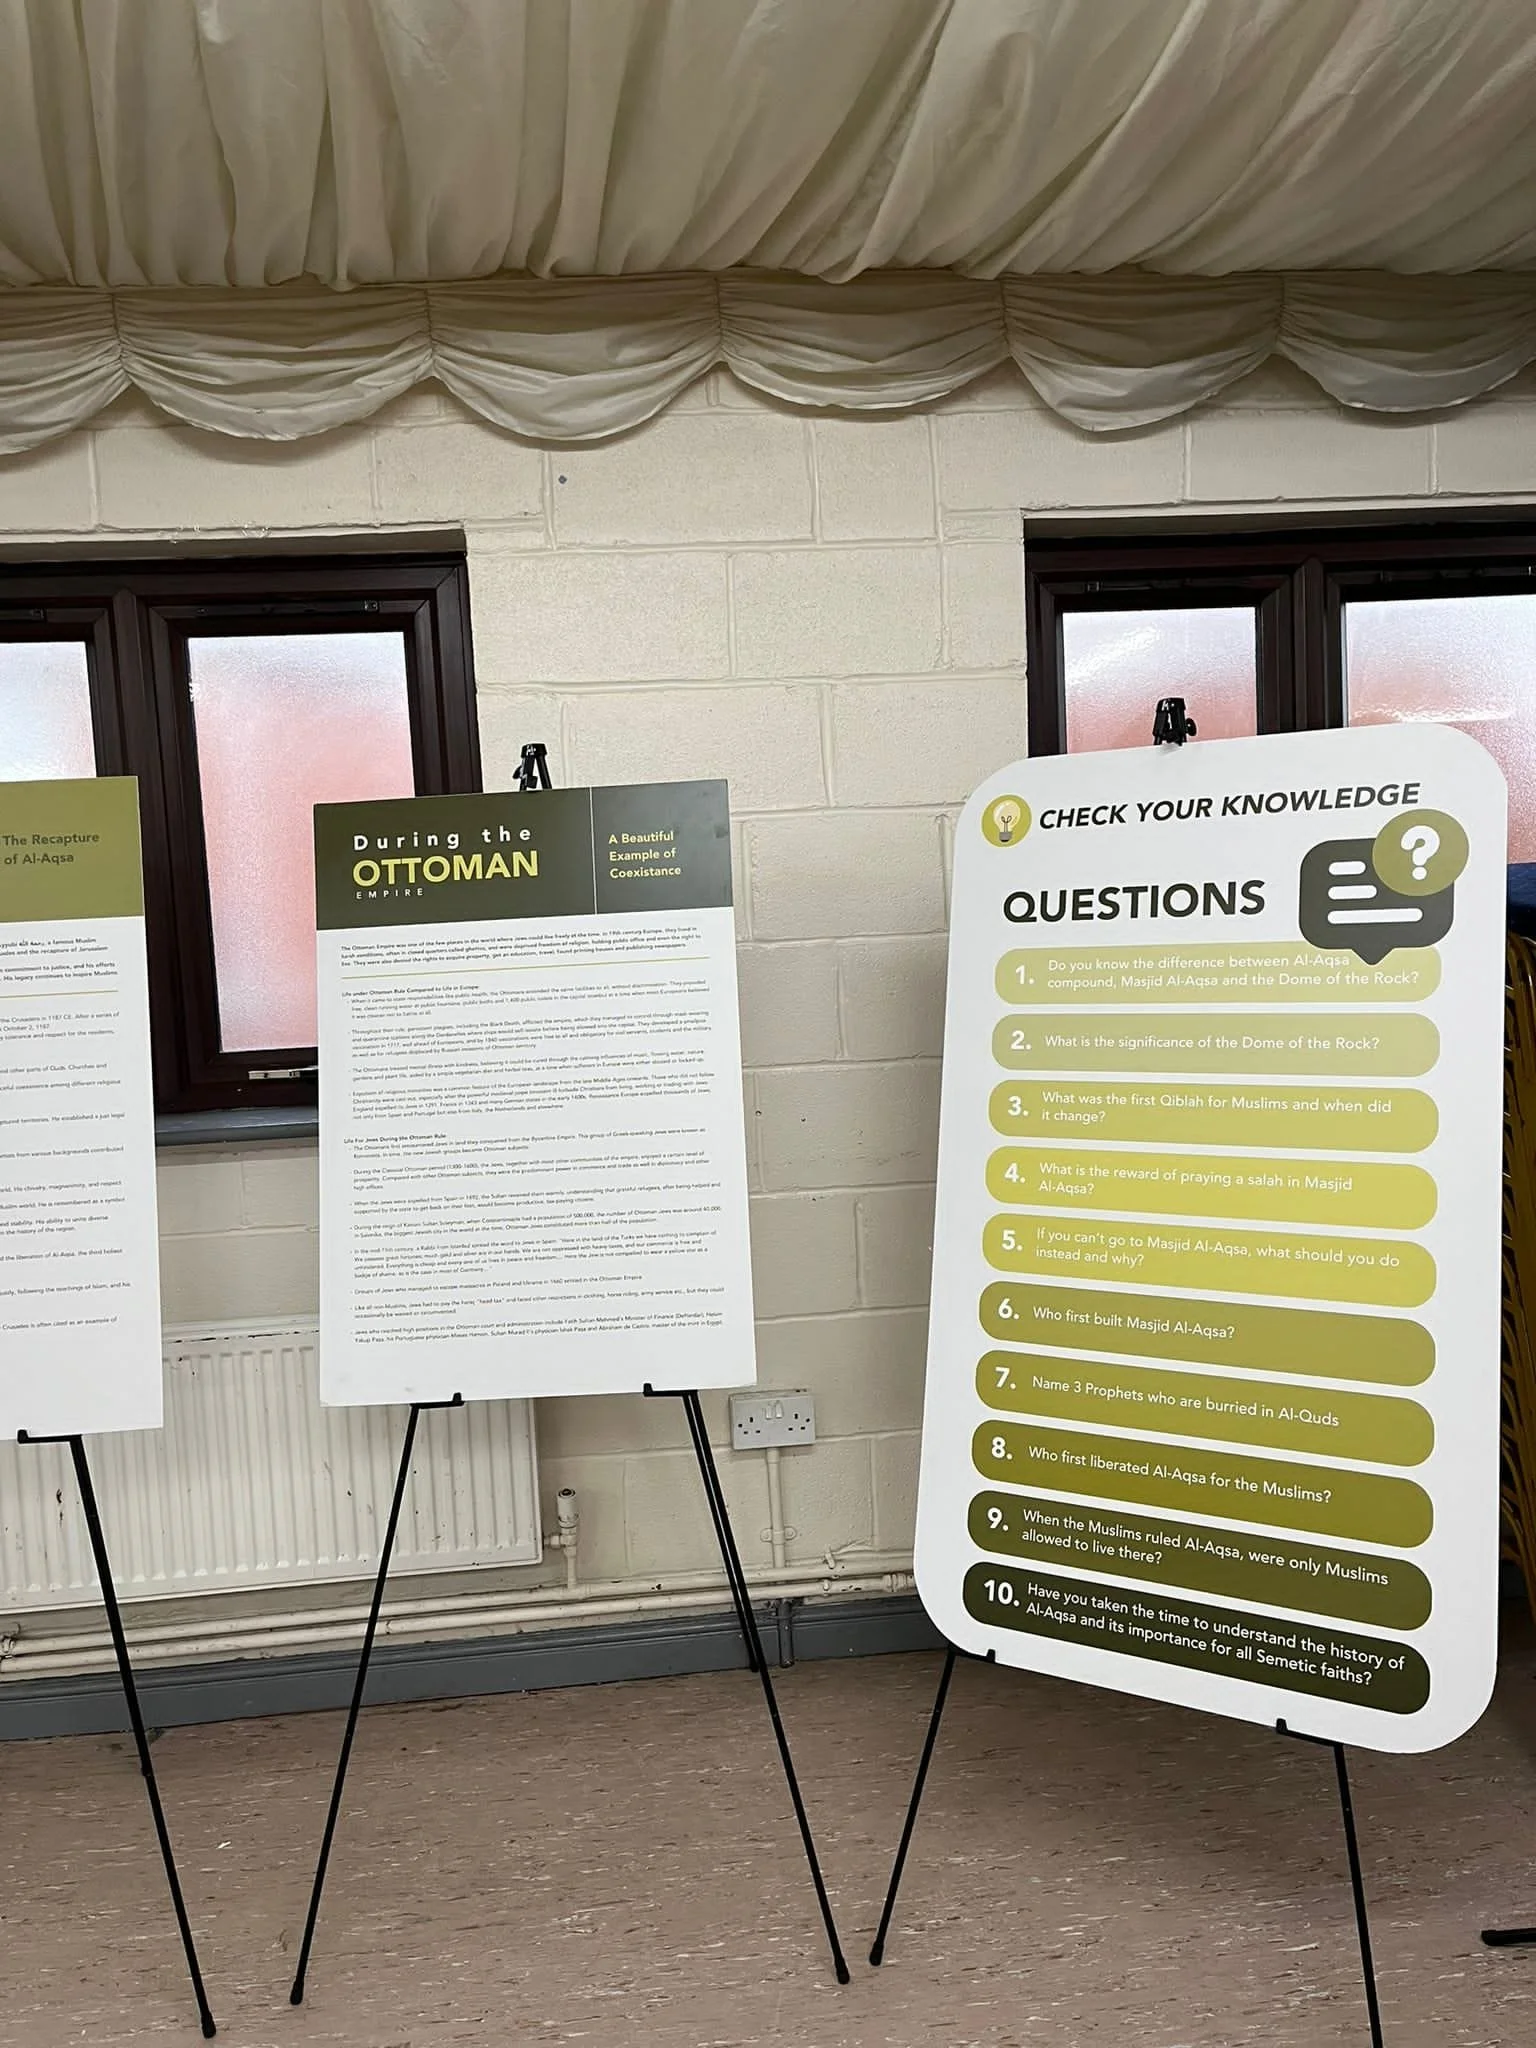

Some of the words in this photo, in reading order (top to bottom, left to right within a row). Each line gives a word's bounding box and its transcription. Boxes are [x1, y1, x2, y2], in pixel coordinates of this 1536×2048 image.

[1040, 804, 1127, 828] CHECK
[1137, 798, 1212, 821] YOUR
[1221, 783, 1419, 816] KNOWLEDGE
[4, 834, 26, 845] The
[32, 834, 99, 846] Recapture
[354, 832, 458, 850] During
[482, 825, 530, 842] the
[609, 834, 617, 843] A
[622, 830, 673, 843] Beautiful
[4, 853, 17, 864] of
[22, 853, 73, 865] Al-Aqsa
[609, 849, 659, 861] Example
[664, 847, 675, 857] of
[353, 850, 537, 886] OTTOMAN
[610, 867, 680, 878] Coexistance
[356, 888, 423, 899] EMPIRE
[1003, 880, 1264, 922] QUESTIONS
[1048, 959, 1065, 970] Do
[1070, 962, 1092, 973] you
[1096, 959, 1129, 969] know
[1133, 958, 1153, 968] the
[1158, 956, 1224, 968] difference
[1229, 956, 1288, 967] between
[1293, 954, 1349, 968] Al-Aqsa
[1016, 965, 1034, 984] 1.
[1048, 976, 1116, 991] compound,
[1121, 975, 1162, 989] Masjid
[1166, 975, 1217, 988] Al-Aqsa
[1222, 974, 1247, 985] and
[1252, 973, 1274, 985] the
[1279, 973, 1321, 984] Dome
[1326, 971, 1340, 984] of
[1345, 972, 1368, 984] the
[1374, 971, 1418, 983] Rock?
[1011, 1030, 1031, 1049] 2.
[1045, 1035, 1078, 1046] What
[1081, 1036, 1090, 1046] is
[1094, 1035, 1114, 1046] the
[1119, 1035, 1193, 1049] significance
[1198, 1036, 1211, 1047] of
[1215, 1036, 1237, 1048] the
[1242, 1036, 1284, 1048] Dome
[1288, 1036, 1303, 1048] of
[1307, 1037, 1330, 1048] the
[1336, 1037, 1379, 1049] Rock?
[1008, 1096, 1028, 1115] 3.
[1042, 1091, 1074, 1103] What
[1078, 1096, 1102, 1104] was
[1104, 1093, 1126, 1104] the
[1131, 1093, 1155, 1105] first
[1160, 1094, 1203, 1107] Qiblah
[1208, 1095, 1227, 1107] for
[1232, 1096, 1287, 1109] Muslims
[1292, 1098, 1318, 1110] and
[1324, 1099, 1362, 1111] when
[1368, 1100, 1391, 1112] did
[1042, 1111, 1049, 1120] it
[1054, 1110, 1105, 1124] change?
[1004, 1163, 1024, 1182] 4.
[1040, 1162, 1072, 1175] What
[1076, 1167, 1085, 1175] is
[1087, 1165, 1109, 1176] the
[1114, 1168, 1158, 1179] reward
[1163, 1169, 1176, 1180] of
[1180, 1172, 1231, 1187] praying
[1235, 1176, 1243, 1184] a
[1248, 1174, 1282, 1186] salah
[1288, 1176, 1299, 1186] in
[1305, 1175, 1351, 1192] Masjid
[1039, 1180, 1094, 1195] Al-Aqsa?
[1002, 1229, 1022, 1250] 5.
[1037, 1227, 1044, 1239] If
[1048, 1232, 1070, 1243] you
[1074, 1233, 1106, 1246] can't
[1108, 1236, 1125, 1248] go
[1129, 1237, 1143, 1246] to
[1147, 1236, 1189, 1252] Masjid
[1194, 1240, 1250, 1256] Al-Aqsa,
[1256, 1245, 1290, 1258] what
[1294, 1247, 1342, 1262] should
[1347, 1255, 1374, 1266] you
[1379, 1254, 1399, 1266] do
[1036, 1246, 1080, 1260] instead
[1084, 1251, 1107, 1262] and
[1112, 1253, 1143, 1268] why?
[998, 1298, 1018, 1319] 6.
[1033, 1306, 1061, 1320] Who
[1065, 1309, 1089, 1323] first
[1094, 1312, 1122, 1326] built
[1127, 1316, 1169, 1333] Masjid
[1173, 1321, 1234, 1339] Al-Aqsa?
[995, 1367, 1015, 1388] 7.
[1033, 1375, 1069, 1391] Name
[1074, 1381, 1081, 1392] 3
[1085, 1382, 1143, 1400] Prophets
[1147, 1391, 1175, 1404] who
[1180, 1397, 1201, 1408] are
[1206, 1397, 1256, 1415] burried
[1262, 1404, 1273, 1417] in
[1278, 1407, 1338, 1426] Al-Quds
[992, 1437, 1011, 1459] 8.
[1029, 1446, 1057, 1460] Who
[1061, 1450, 1085, 1465] first
[1090, 1454, 1148, 1474] liberated
[1152, 1465, 1205, 1484] Al-Aqsa
[1210, 1472, 1230, 1487] for
[1234, 1476, 1257, 1491] the
[1263, 1481, 1330, 1502] Muslims?
[987, 1507, 1008, 1530] 9.
[1022, 1529, 1070, 1547] allowed
[1074, 1539, 1088, 1550] to
[1093, 1539, 1114, 1555] live
[1118, 1545, 1161, 1563] there?
[1023, 1509, 1058, 1526] When
[1063, 1516, 1084, 1530] the
[1088, 1520, 1141, 1540] Muslims
[1146, 1531, 1180, 1547] ruled
[1184, 1537, 1243, 1560] Al-Aqsa,
[1248, 1551, 1284, 1565] were
[1289, 1557, 1320, 1575] only
[1326, 1561, 1388, 1584] Muslims
[984, 1579, 1019, 1606] 10.
[1028, 1582, 1059, 1599] Have
[1063, 1593, 1087, 1605] you
[1091, 1596, 1127, 1613] taken
[1132, 1603, 1154, 1618] the
[1158, 1609, 1189, 1625] time
[1193, 1617, 1208, 1629] to
[1213, 1623, 1295, 1648] understand
[1300, 1637, 1325, 1653] the
[1330, 1642, 1383, 1668] history
[1388, 1656, 1404, 1669] of
[1026, 1603, 1075, 1623] Al-Aqsa
[1080, 1616, 1104, 1628] and
[1109, 1621, 1123, 1632] its
[1128, 1626, 1206, 1650] importance
[1211, 1639, 1231, 1655] for
[1236, 1646, 1251, 1660] all
[1257, 1649, 1316, 1673] Semetic
[1320, 1662, 1371, 1684] faiths?
